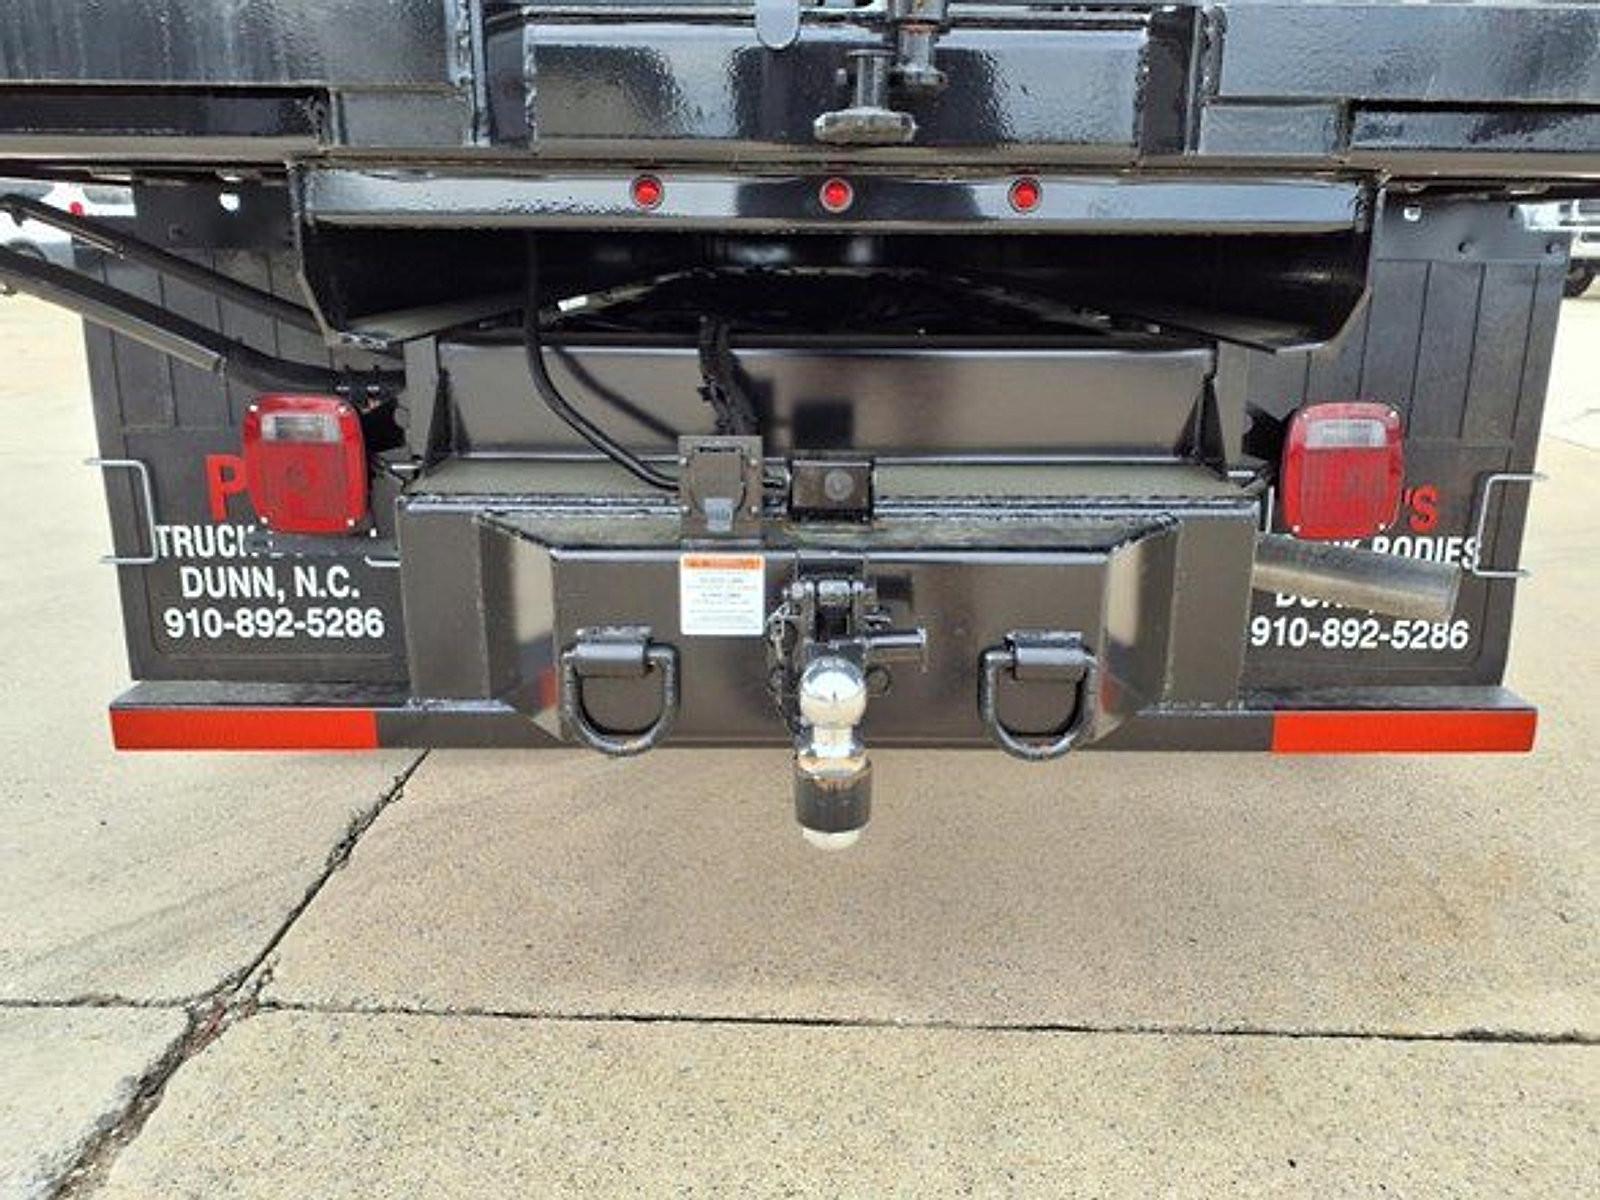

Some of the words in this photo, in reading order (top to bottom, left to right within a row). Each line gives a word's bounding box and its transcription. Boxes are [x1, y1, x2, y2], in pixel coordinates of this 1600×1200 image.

[180, 566, 284, 603] DUNN,
[294, 565, 360, 598] N.C.
[164, 607, 384, 638] 910-892-5286
[1251, 615, 1469, 649] 910-892-5286
